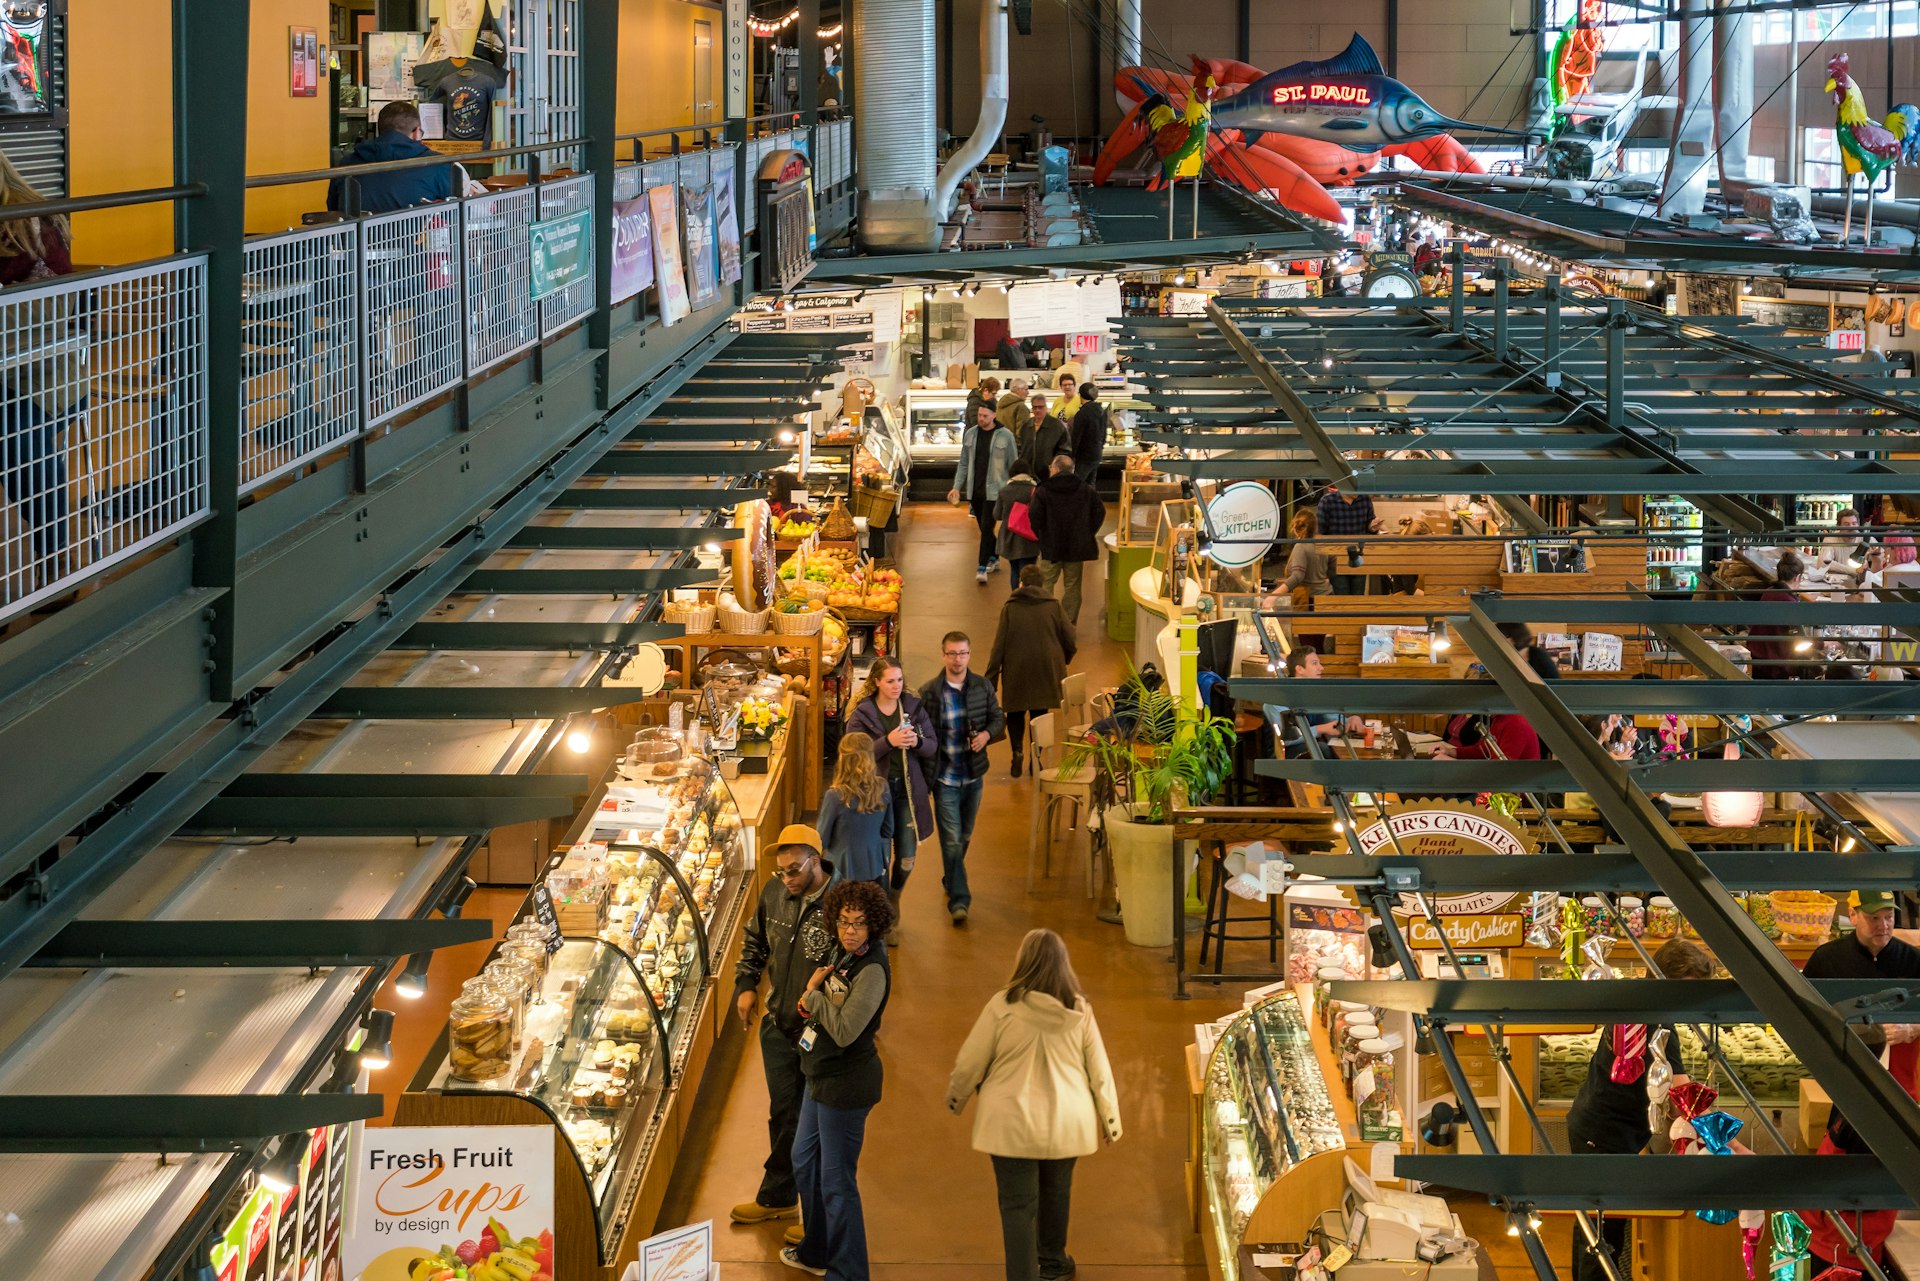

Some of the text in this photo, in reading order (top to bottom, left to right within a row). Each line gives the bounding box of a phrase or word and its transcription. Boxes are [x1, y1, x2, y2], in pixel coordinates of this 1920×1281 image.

[1274, 85, 1371, 104] ST. PAUL
[453, 103, 478, 116] PUBLIC
[1375, 254, 1410, 264] MILWAUKEE
[1075, 335, 1099, 353] EXIT
[1838, 333, 1861, 349] EXIT
[1221, 510, 1249, 524] Green
[1222, 519, 1271, 537] KITCHEN
[1419, 837, 1457, 847] Hand
[1434, 815, 1518, 856] CANDIES
[1411, 846, 1463, 855] Crafted
[1471, 915, 1518, 943] Cashier
[370, 1147, 513, 1170] Fresh Fruit
[375, 1157, 530, 1233] Cups
[375, 1217, 450, 1235] by design
